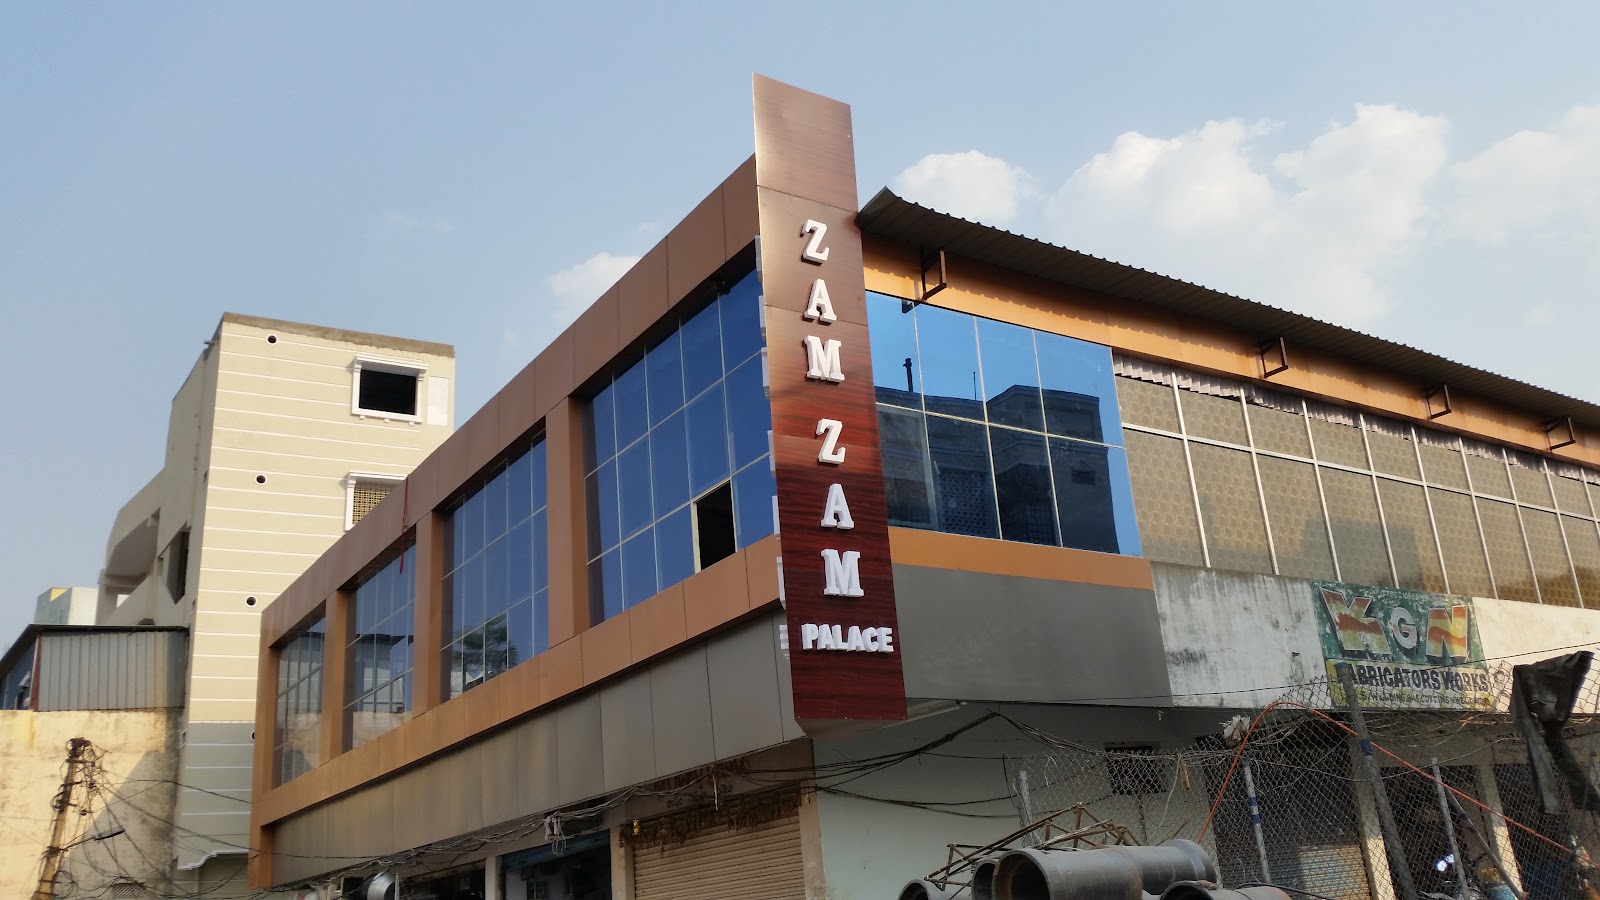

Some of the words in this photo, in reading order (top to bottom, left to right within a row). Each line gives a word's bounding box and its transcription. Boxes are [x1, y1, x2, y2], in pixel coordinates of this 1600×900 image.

[801, 219, 845, 383] ZAM
[816, 418, 865, 598] ZAM
[801, 623, 894, 654] PALACE
[1320, 587, 1468, 658] KGN
[1337, 663, 1441, 691] ABRICATORS
[1442, 669, 1491, 692] WORKS
